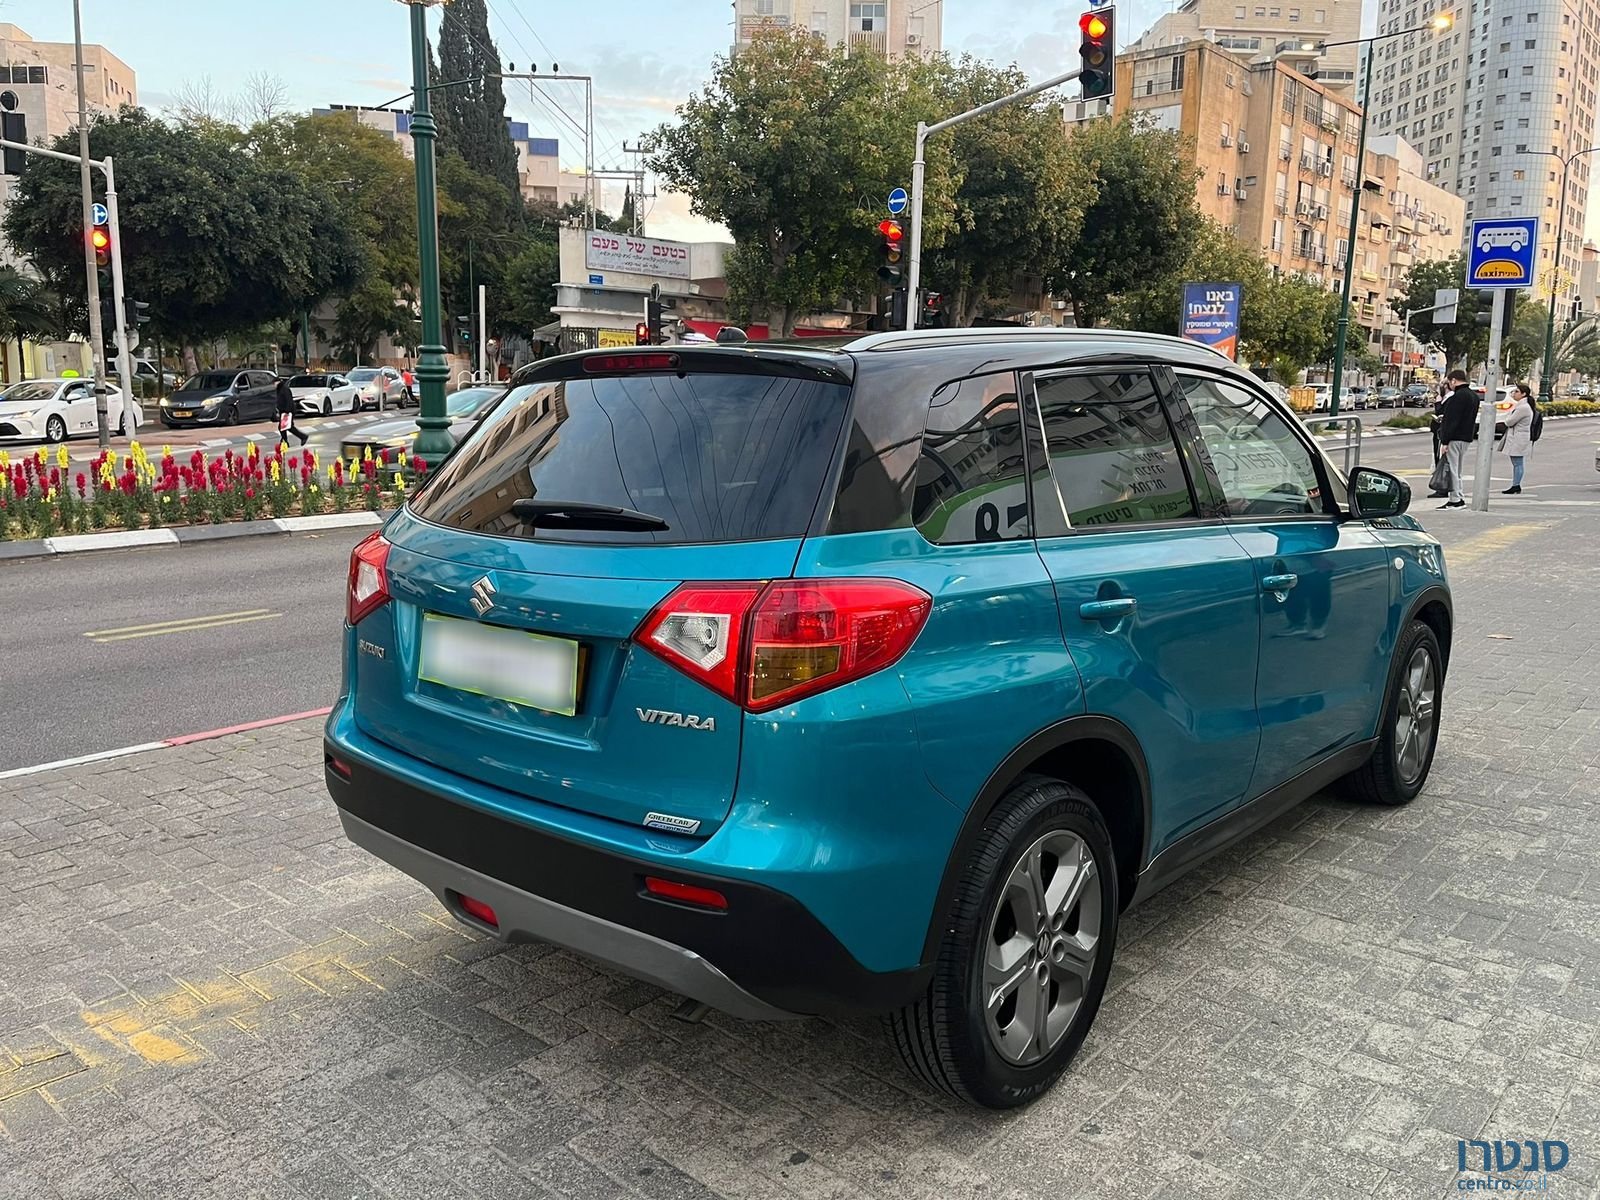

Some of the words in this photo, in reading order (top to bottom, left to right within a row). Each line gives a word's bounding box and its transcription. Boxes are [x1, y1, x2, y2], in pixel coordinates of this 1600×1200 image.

[591, 236, 619, 250] פעם
[626, 238, 646, 253] של
[652, 245, 686, 259] בטעם
[1206, 290, 1234, 301] באנו
[1188, 302, 1225, 315] לנצח!
[359, 639, 385, 659] SUZUKI
[635, 707, 716, 732] VITARA
[648, 813, 673, 823] GREEN
[673, 817, 689, 826] CAR
